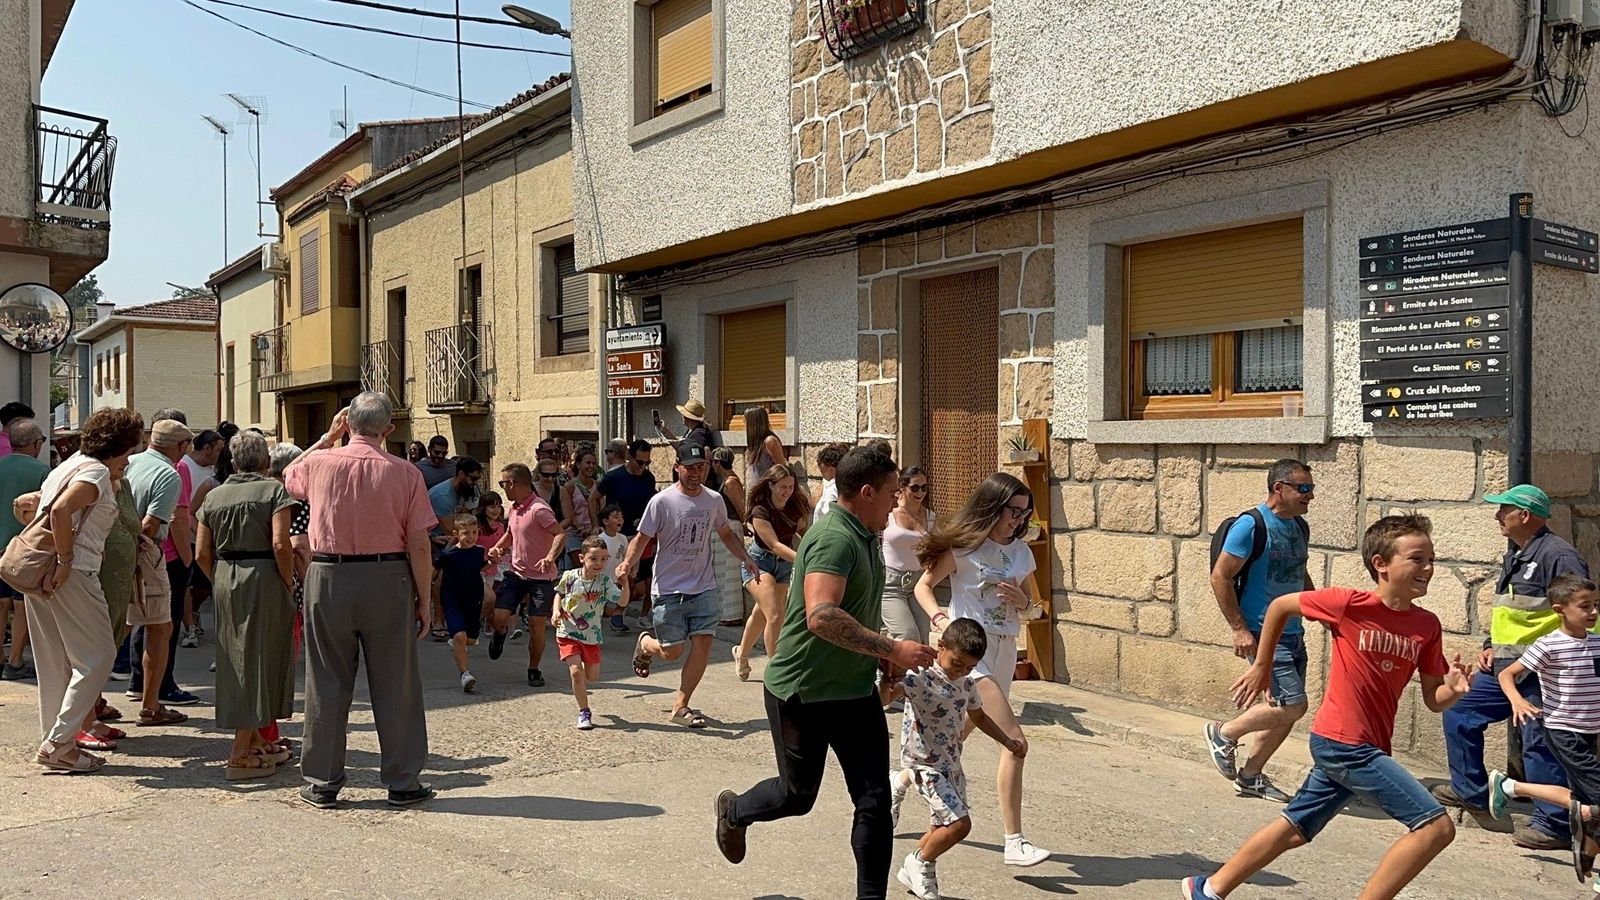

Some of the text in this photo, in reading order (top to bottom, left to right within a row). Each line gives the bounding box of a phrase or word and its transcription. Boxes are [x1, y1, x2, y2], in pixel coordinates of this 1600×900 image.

[1402, 227, 1475, 243] Senderos Naturales
[1402, 248, 1475, 264] Senderos Naturales
[1402, 270, 1479, 284] Miradores Naturales
[1402, 300, 1426, 309] Ermita
[1440, 298, 1448, 306] La
[1450, 296, 1472, 305] Santa
[1371, 324, 1406, 333] Rinconada
[1408, 322, 1418, 331] de
[1420, 321, 1432, 329] Las
[1434, 318, 1460, 328] Arribes
[608, 332, 642, 345] ayuntamiento
[1386, 345, 1407, 353] Portal
[1434, 341, 1460, 350] Arribes
[616, 363, 632, 371] Santa
[1413, 364, 1430, 372] Casa
[1433, 364, 1460, 372] Simona
[616, 387, 639, 395] Salvador
[1406, 383, 1481, 396] Cruz del Posadero
[1406, 403, 1437, 412] Camping
